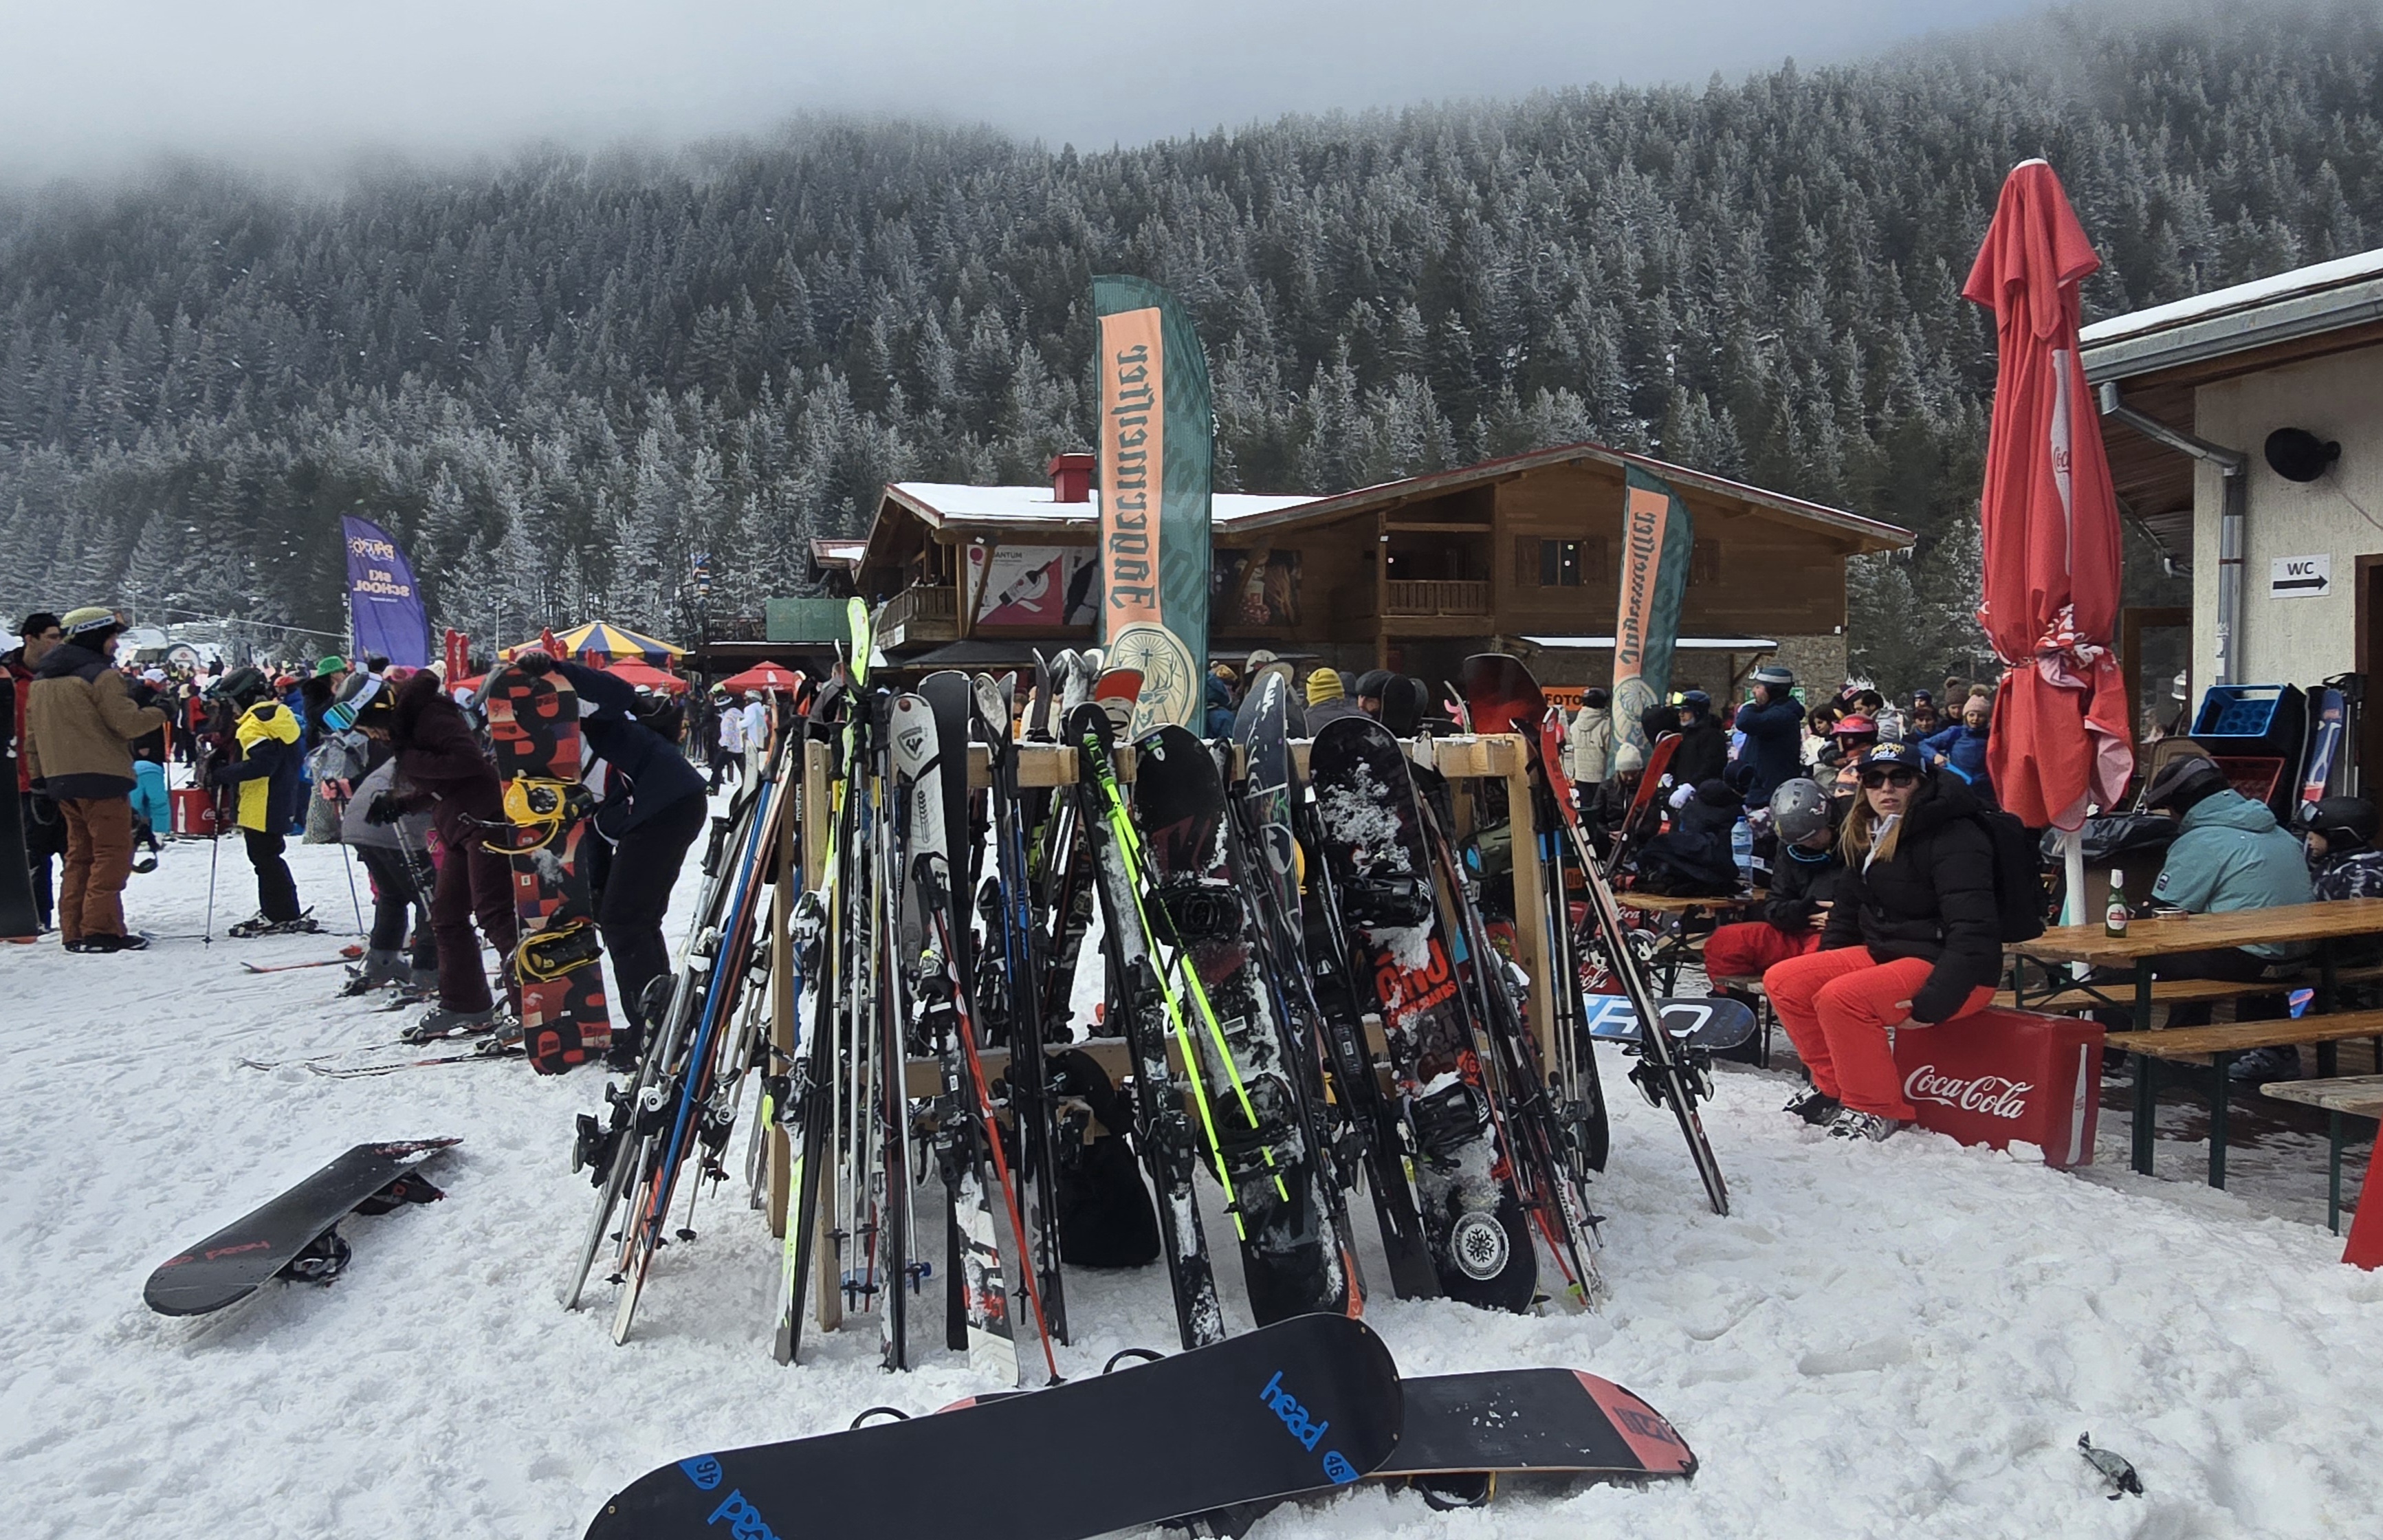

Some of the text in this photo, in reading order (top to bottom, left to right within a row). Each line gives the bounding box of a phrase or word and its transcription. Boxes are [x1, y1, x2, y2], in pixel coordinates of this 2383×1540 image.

[2287, 562, 2314, 575] WC
[1545, 694, 1582, 705] FOTO
[1904, 1064, 2034, 1119] Coca-Cola
[1260, 1370, 1329, 1452] head
[696, 1460, 718, 1484] 46
[1326, 1455, 1345, 1477] 46
